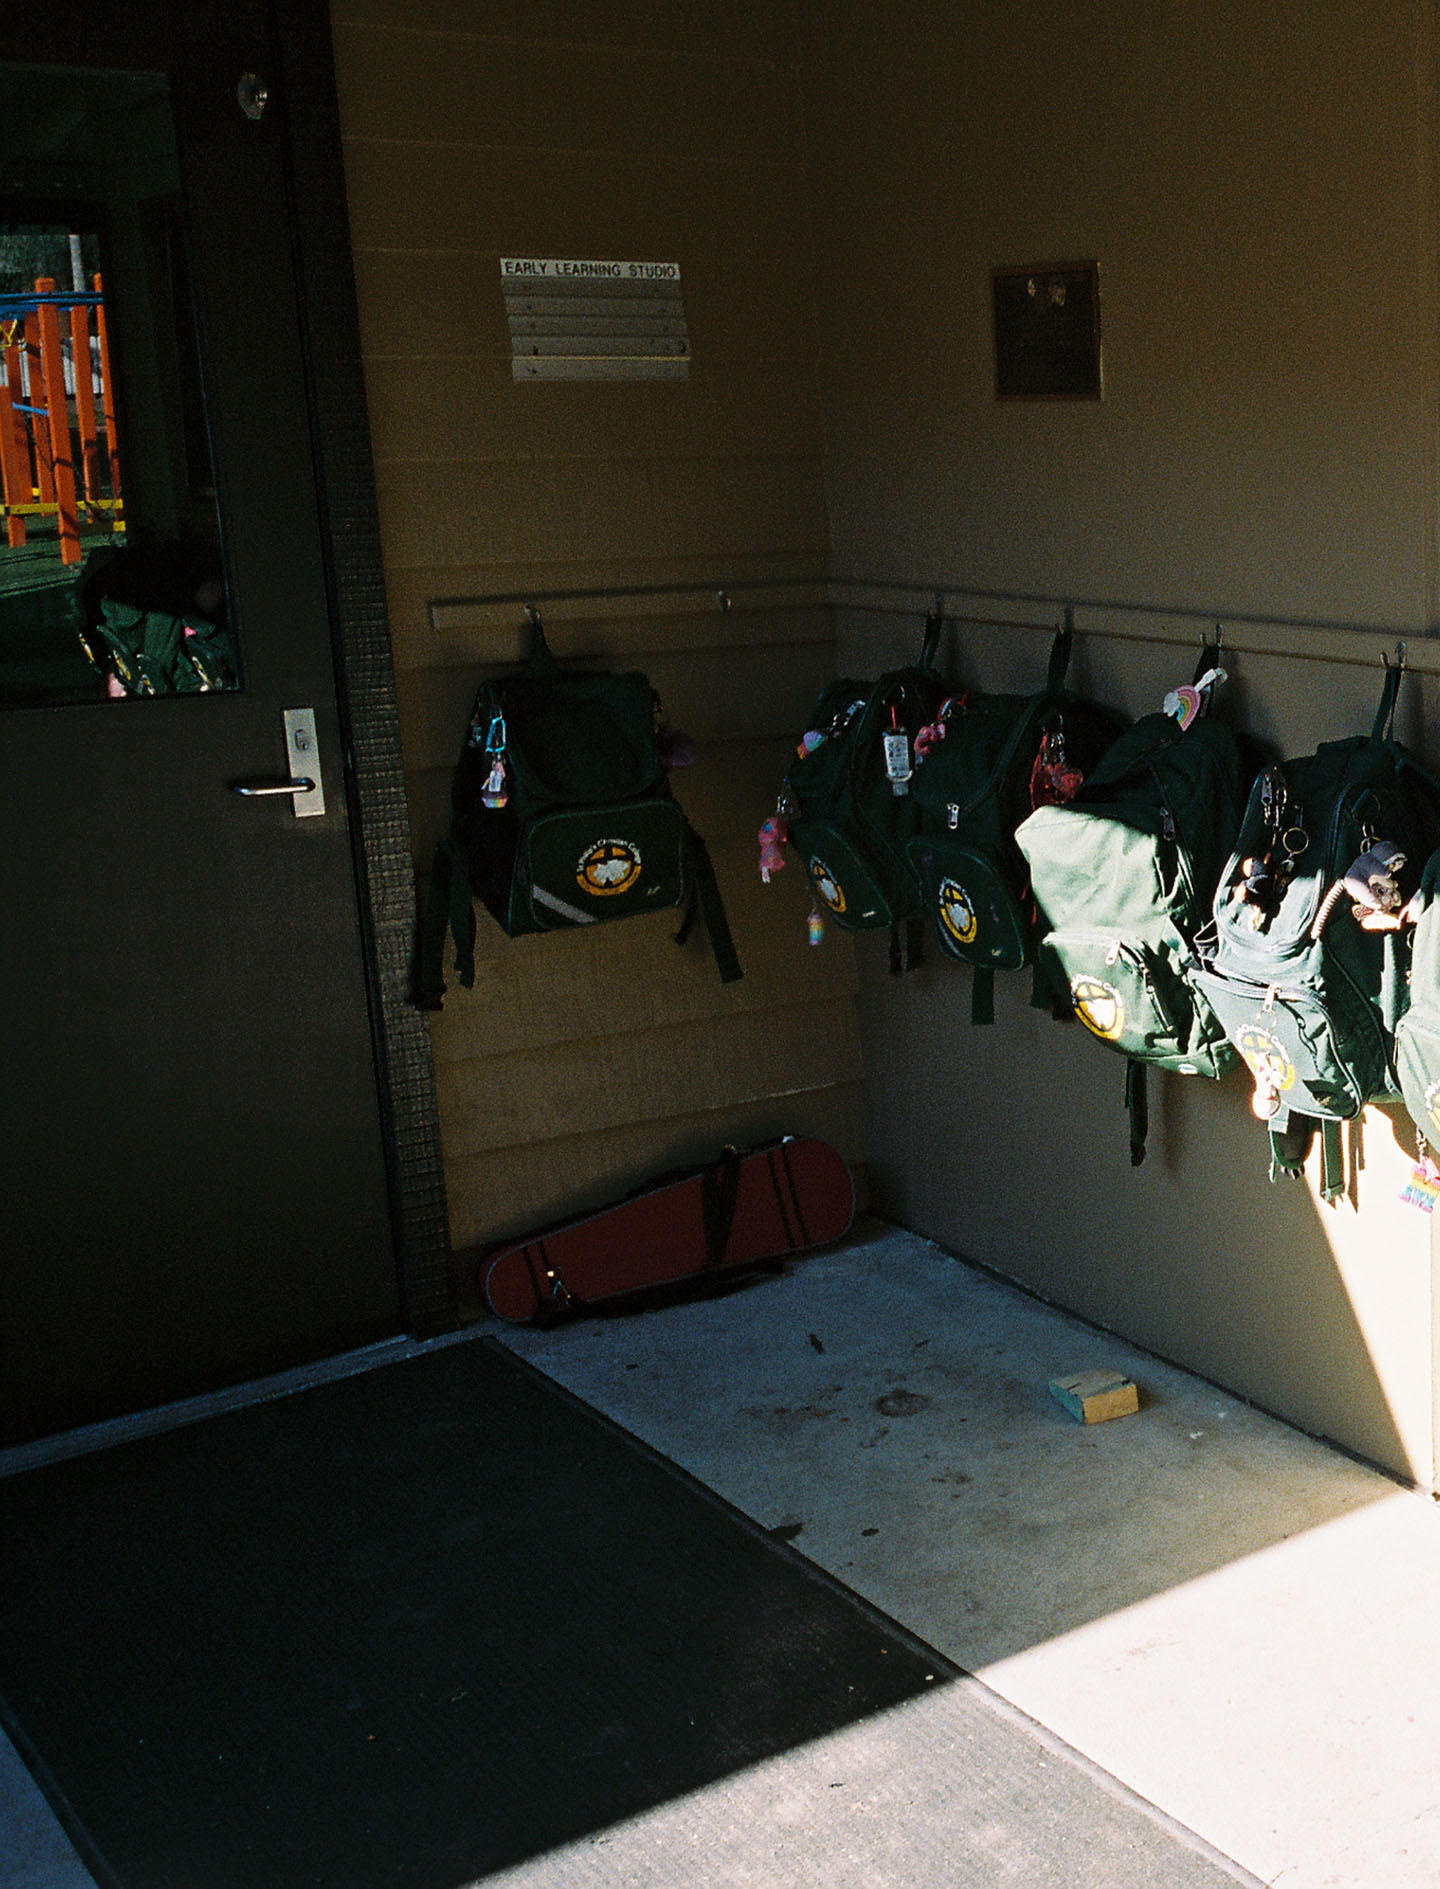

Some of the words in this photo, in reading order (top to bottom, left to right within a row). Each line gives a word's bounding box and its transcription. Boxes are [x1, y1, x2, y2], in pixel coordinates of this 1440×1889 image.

[504, 261, 547, 275] EARLY
[555, 262, 621, 277] LEARNING
[628, 264, 677, 279] STUDIO
